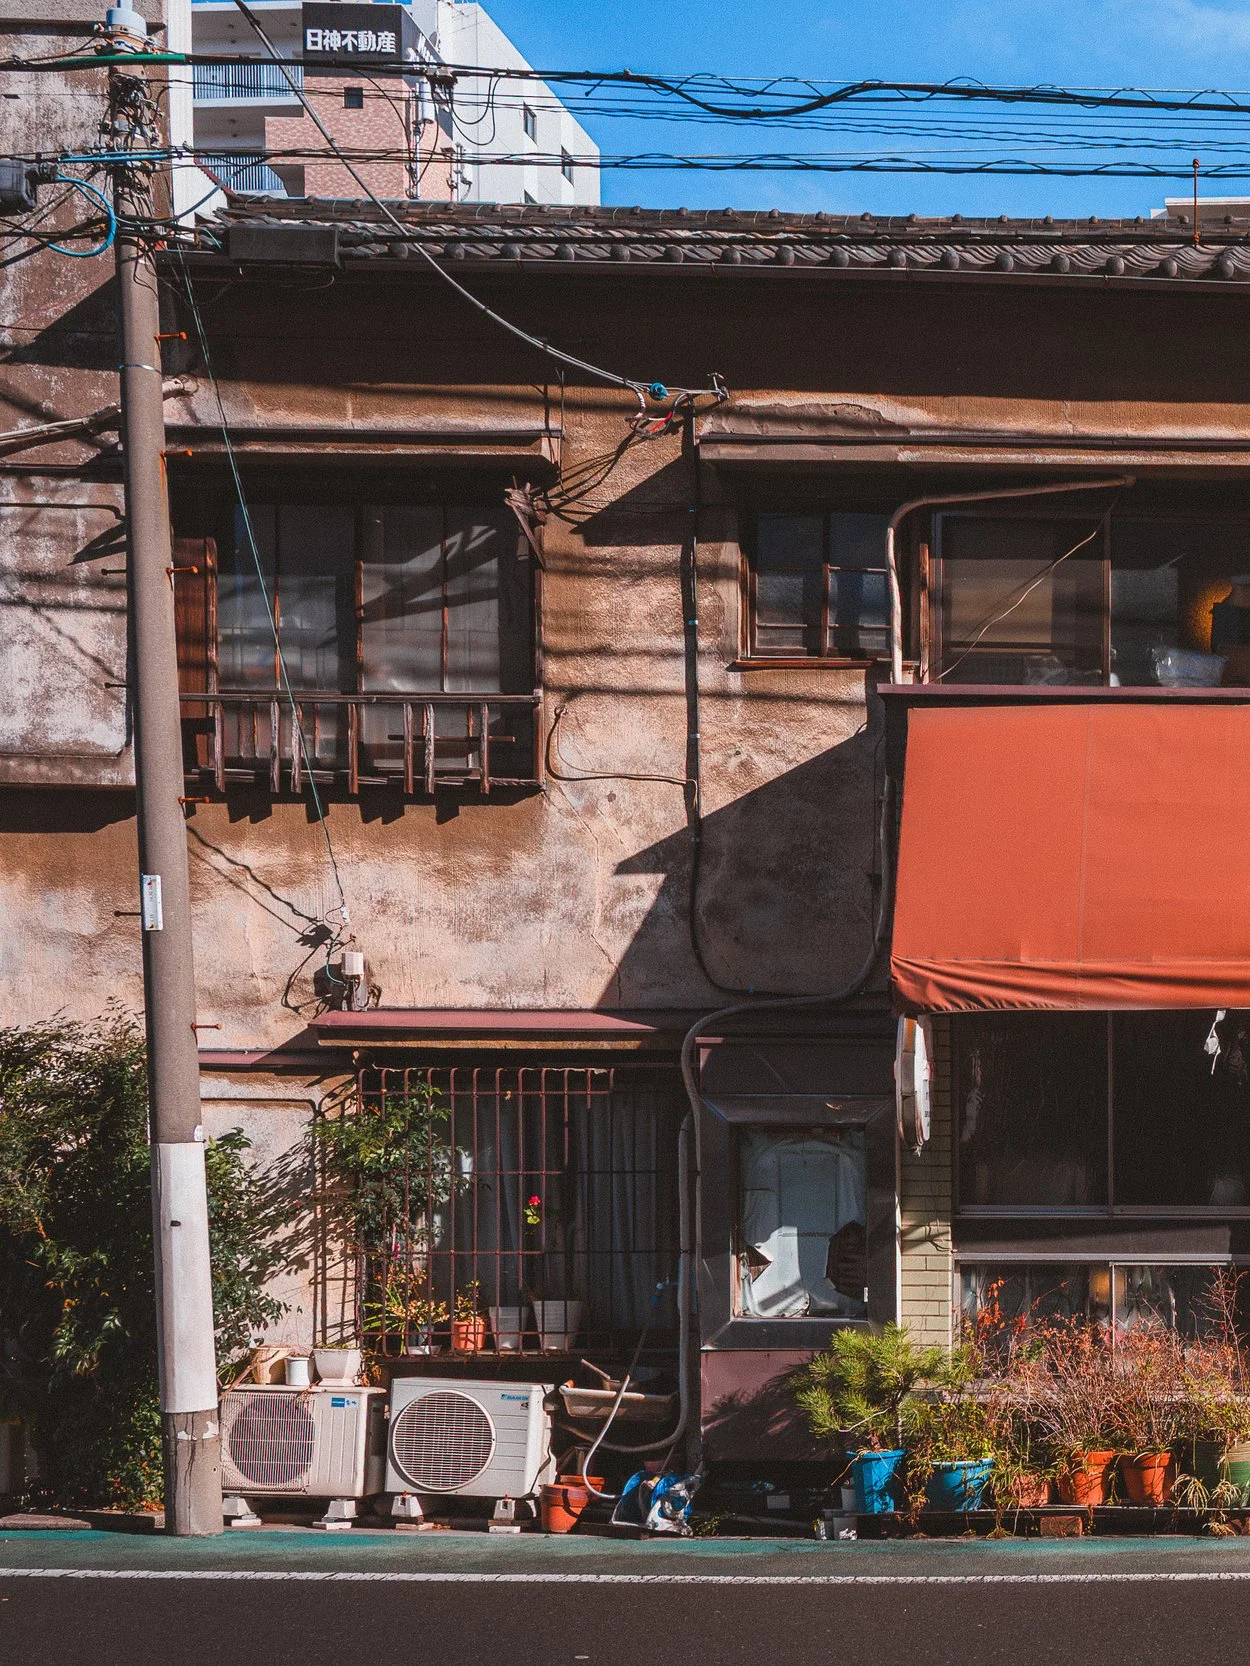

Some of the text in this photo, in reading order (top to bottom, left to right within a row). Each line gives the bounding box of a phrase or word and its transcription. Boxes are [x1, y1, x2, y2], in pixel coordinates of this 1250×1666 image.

[306, 28, 396, 53] 日神不動産
